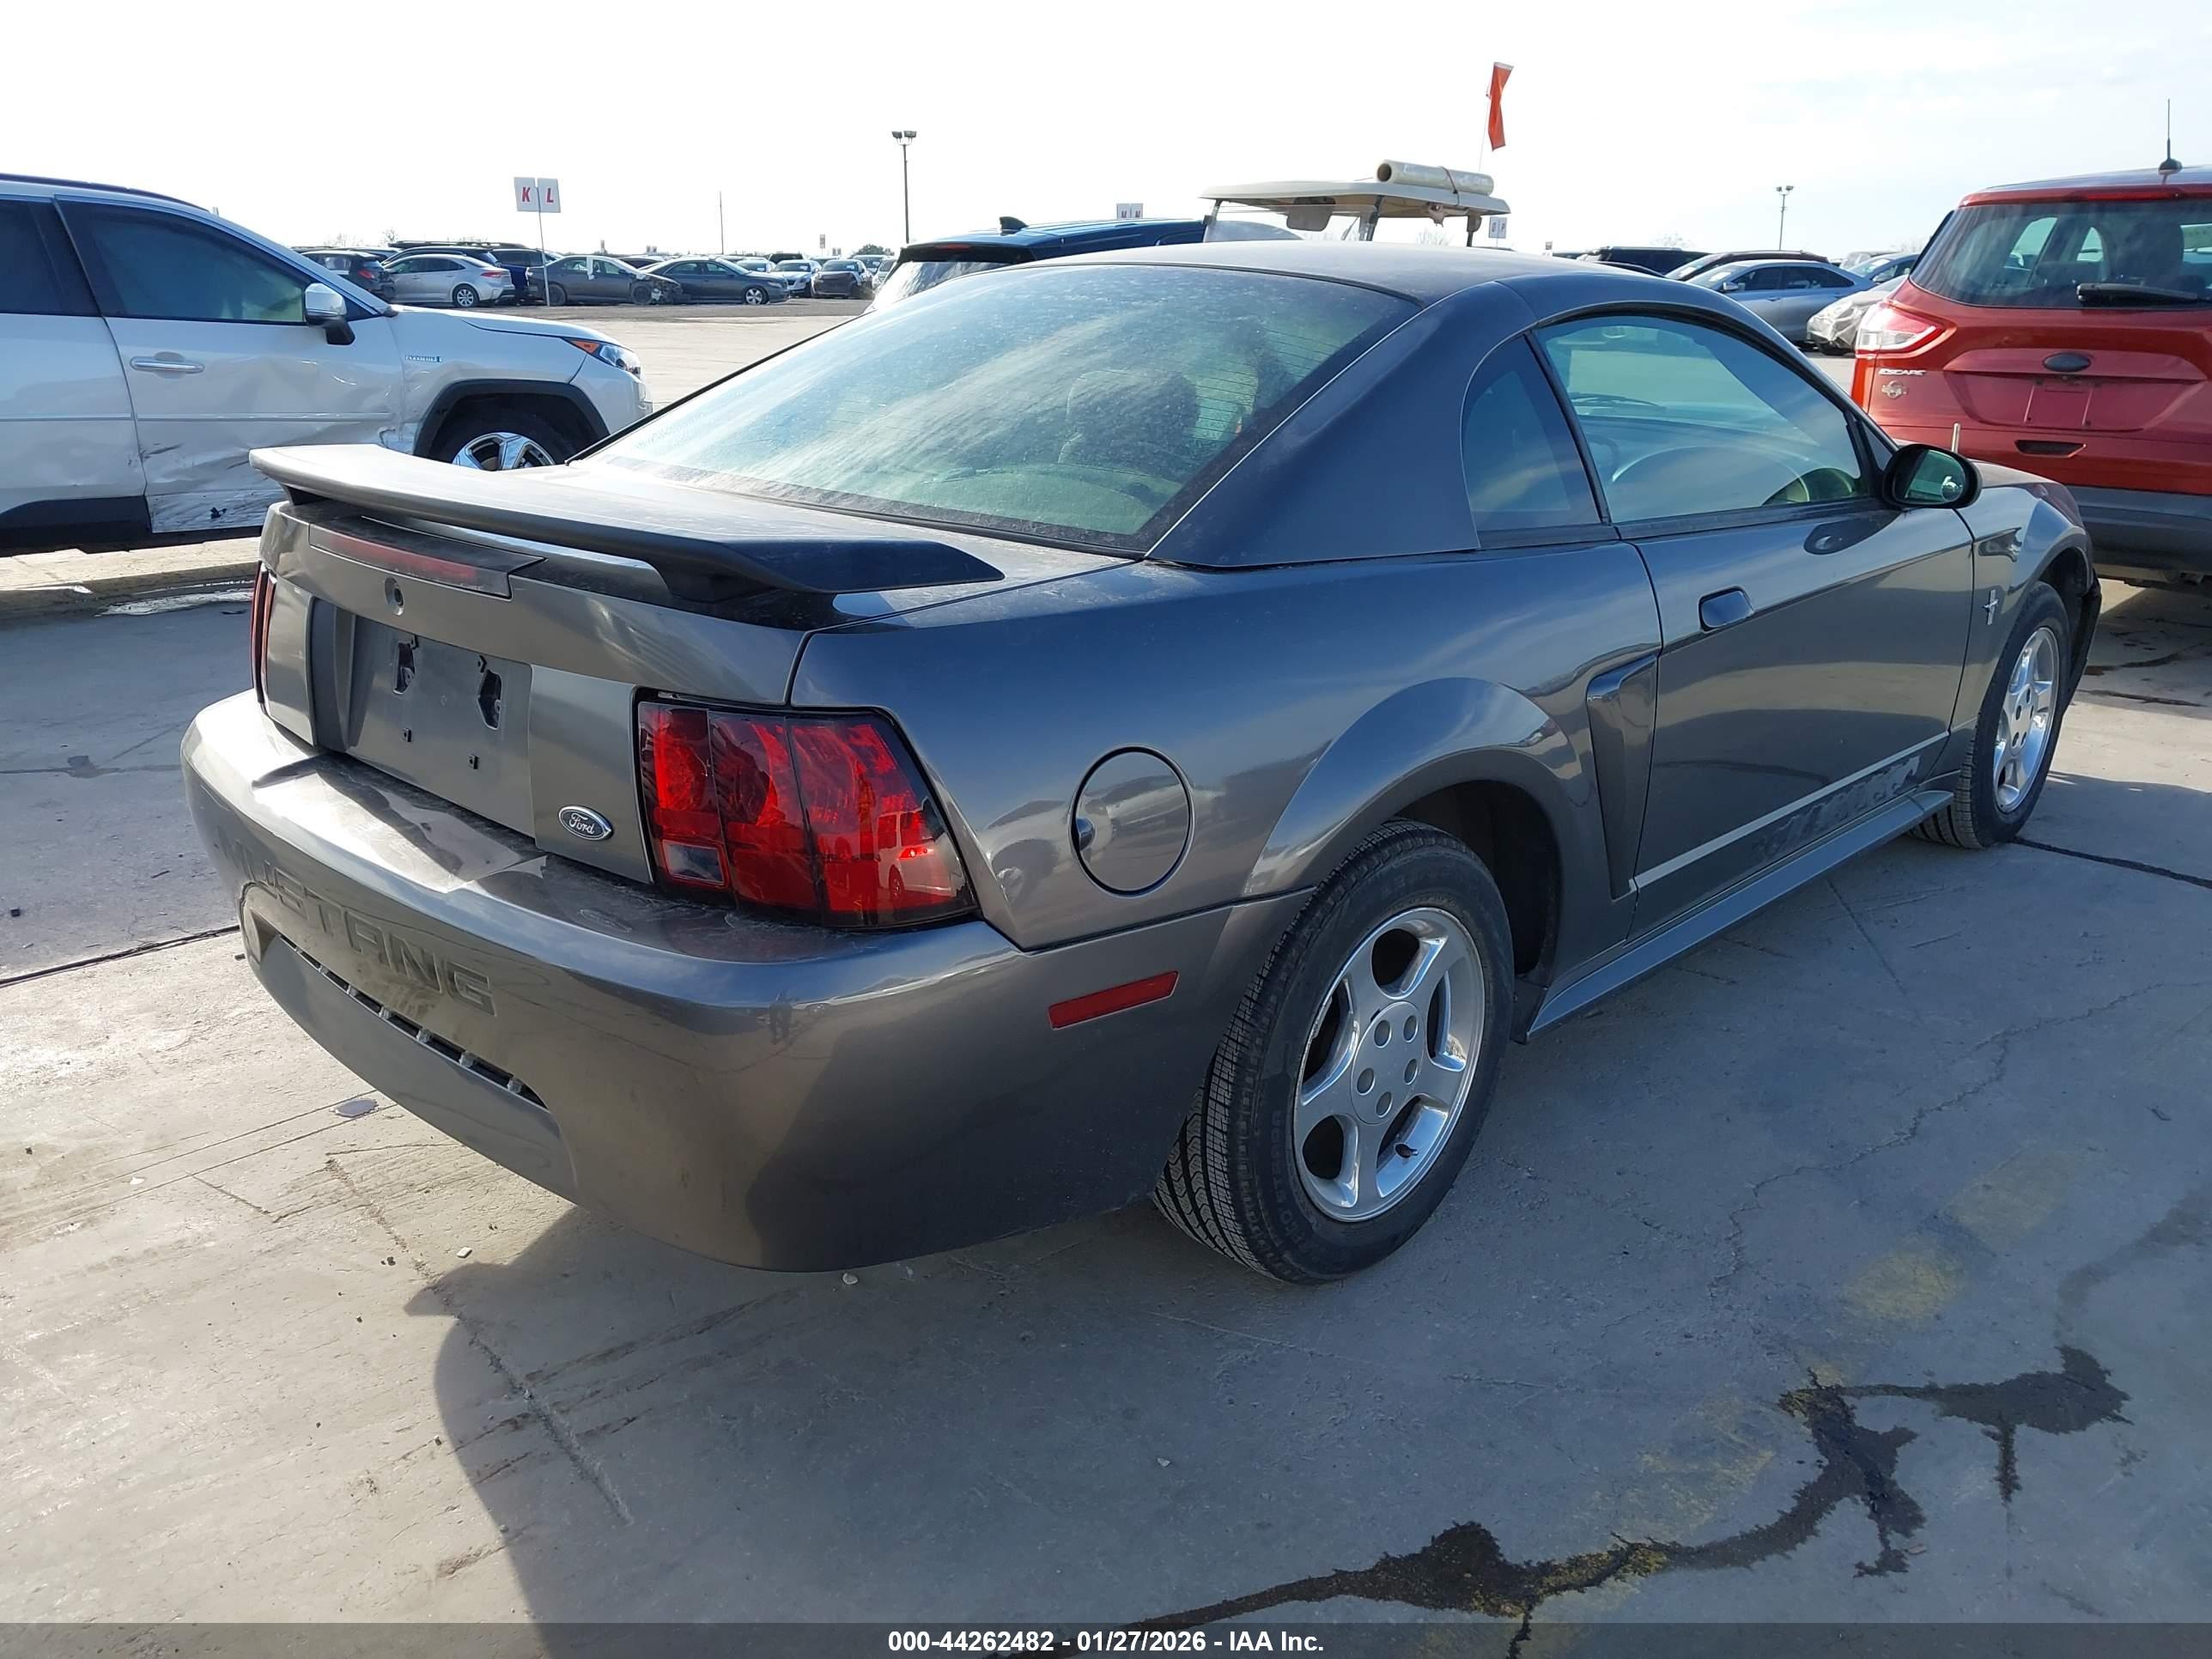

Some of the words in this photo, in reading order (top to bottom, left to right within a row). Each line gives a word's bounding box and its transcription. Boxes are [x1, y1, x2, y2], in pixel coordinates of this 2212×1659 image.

[522, 187, 531, 203] K
[547, 188, 554, 203] L
[568, 812, 594, 834] Ford
